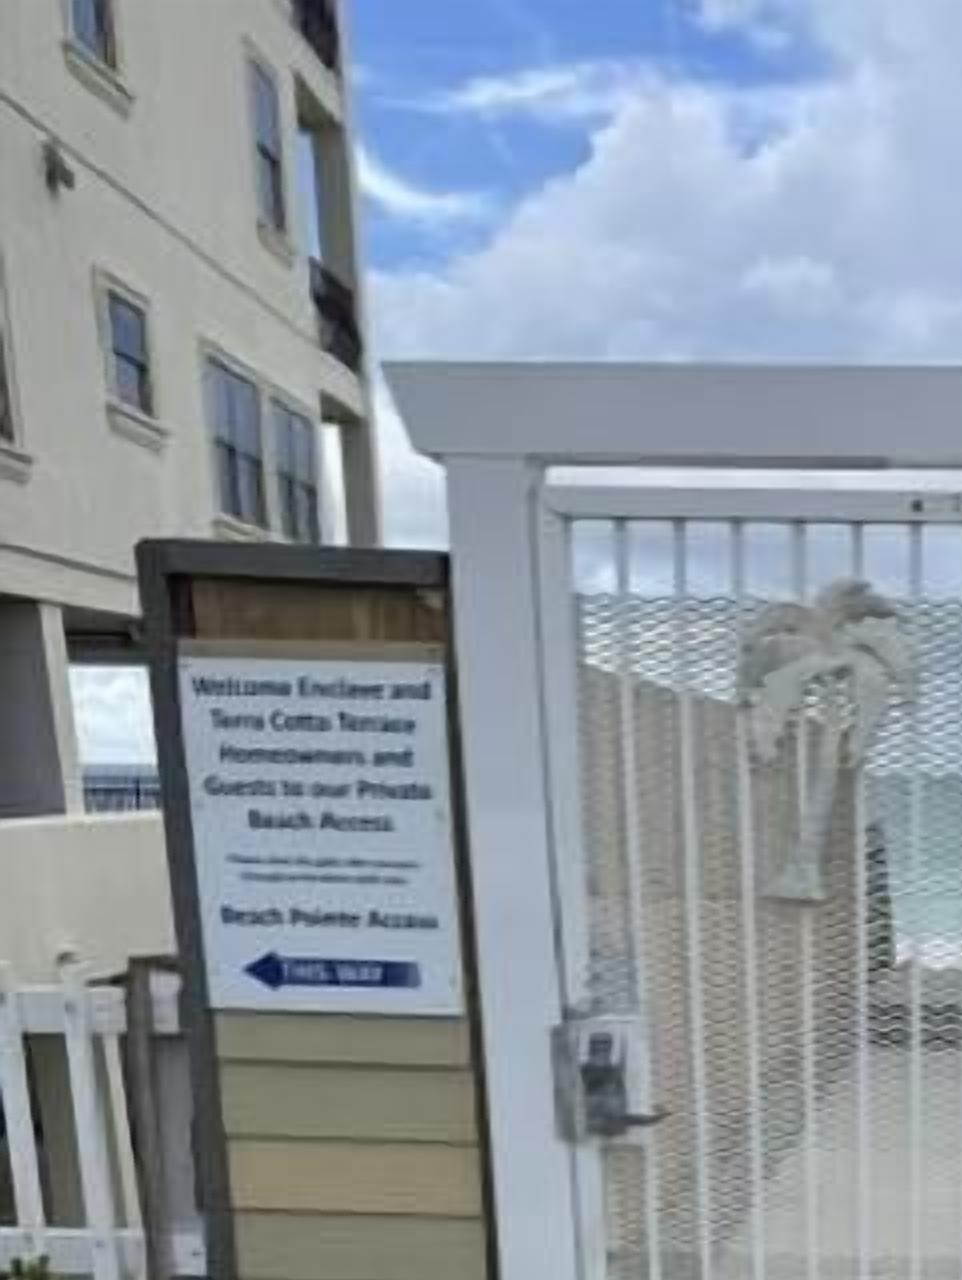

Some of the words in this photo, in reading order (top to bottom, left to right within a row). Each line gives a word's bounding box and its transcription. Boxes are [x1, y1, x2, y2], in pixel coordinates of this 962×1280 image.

[192, 676, 292, 697] Welcome
[298, 676, 384, 699] Enclave
[389, 680, 431, 700] and
[211, 708, 265, 731] Terra
[269, 709, 333, 732] Cotta
[338, 711, 416, 734] Terrace
[220, 742, 366, 765] Homeowners
[373, 747, 414, 767] and
[203, 774, 276, 796] Guests
[281, 780, 304, 797] to
[311, 784, 350, 798] our
[357, 780, 432, 800] Private
[248, 808, 312, 829] Beach
[320, 811, 395, 832] Access
[220, 904, 283, 925] Beach
[367, 910, 439, 929] Access
[335, 964, 383, 983] WAY
